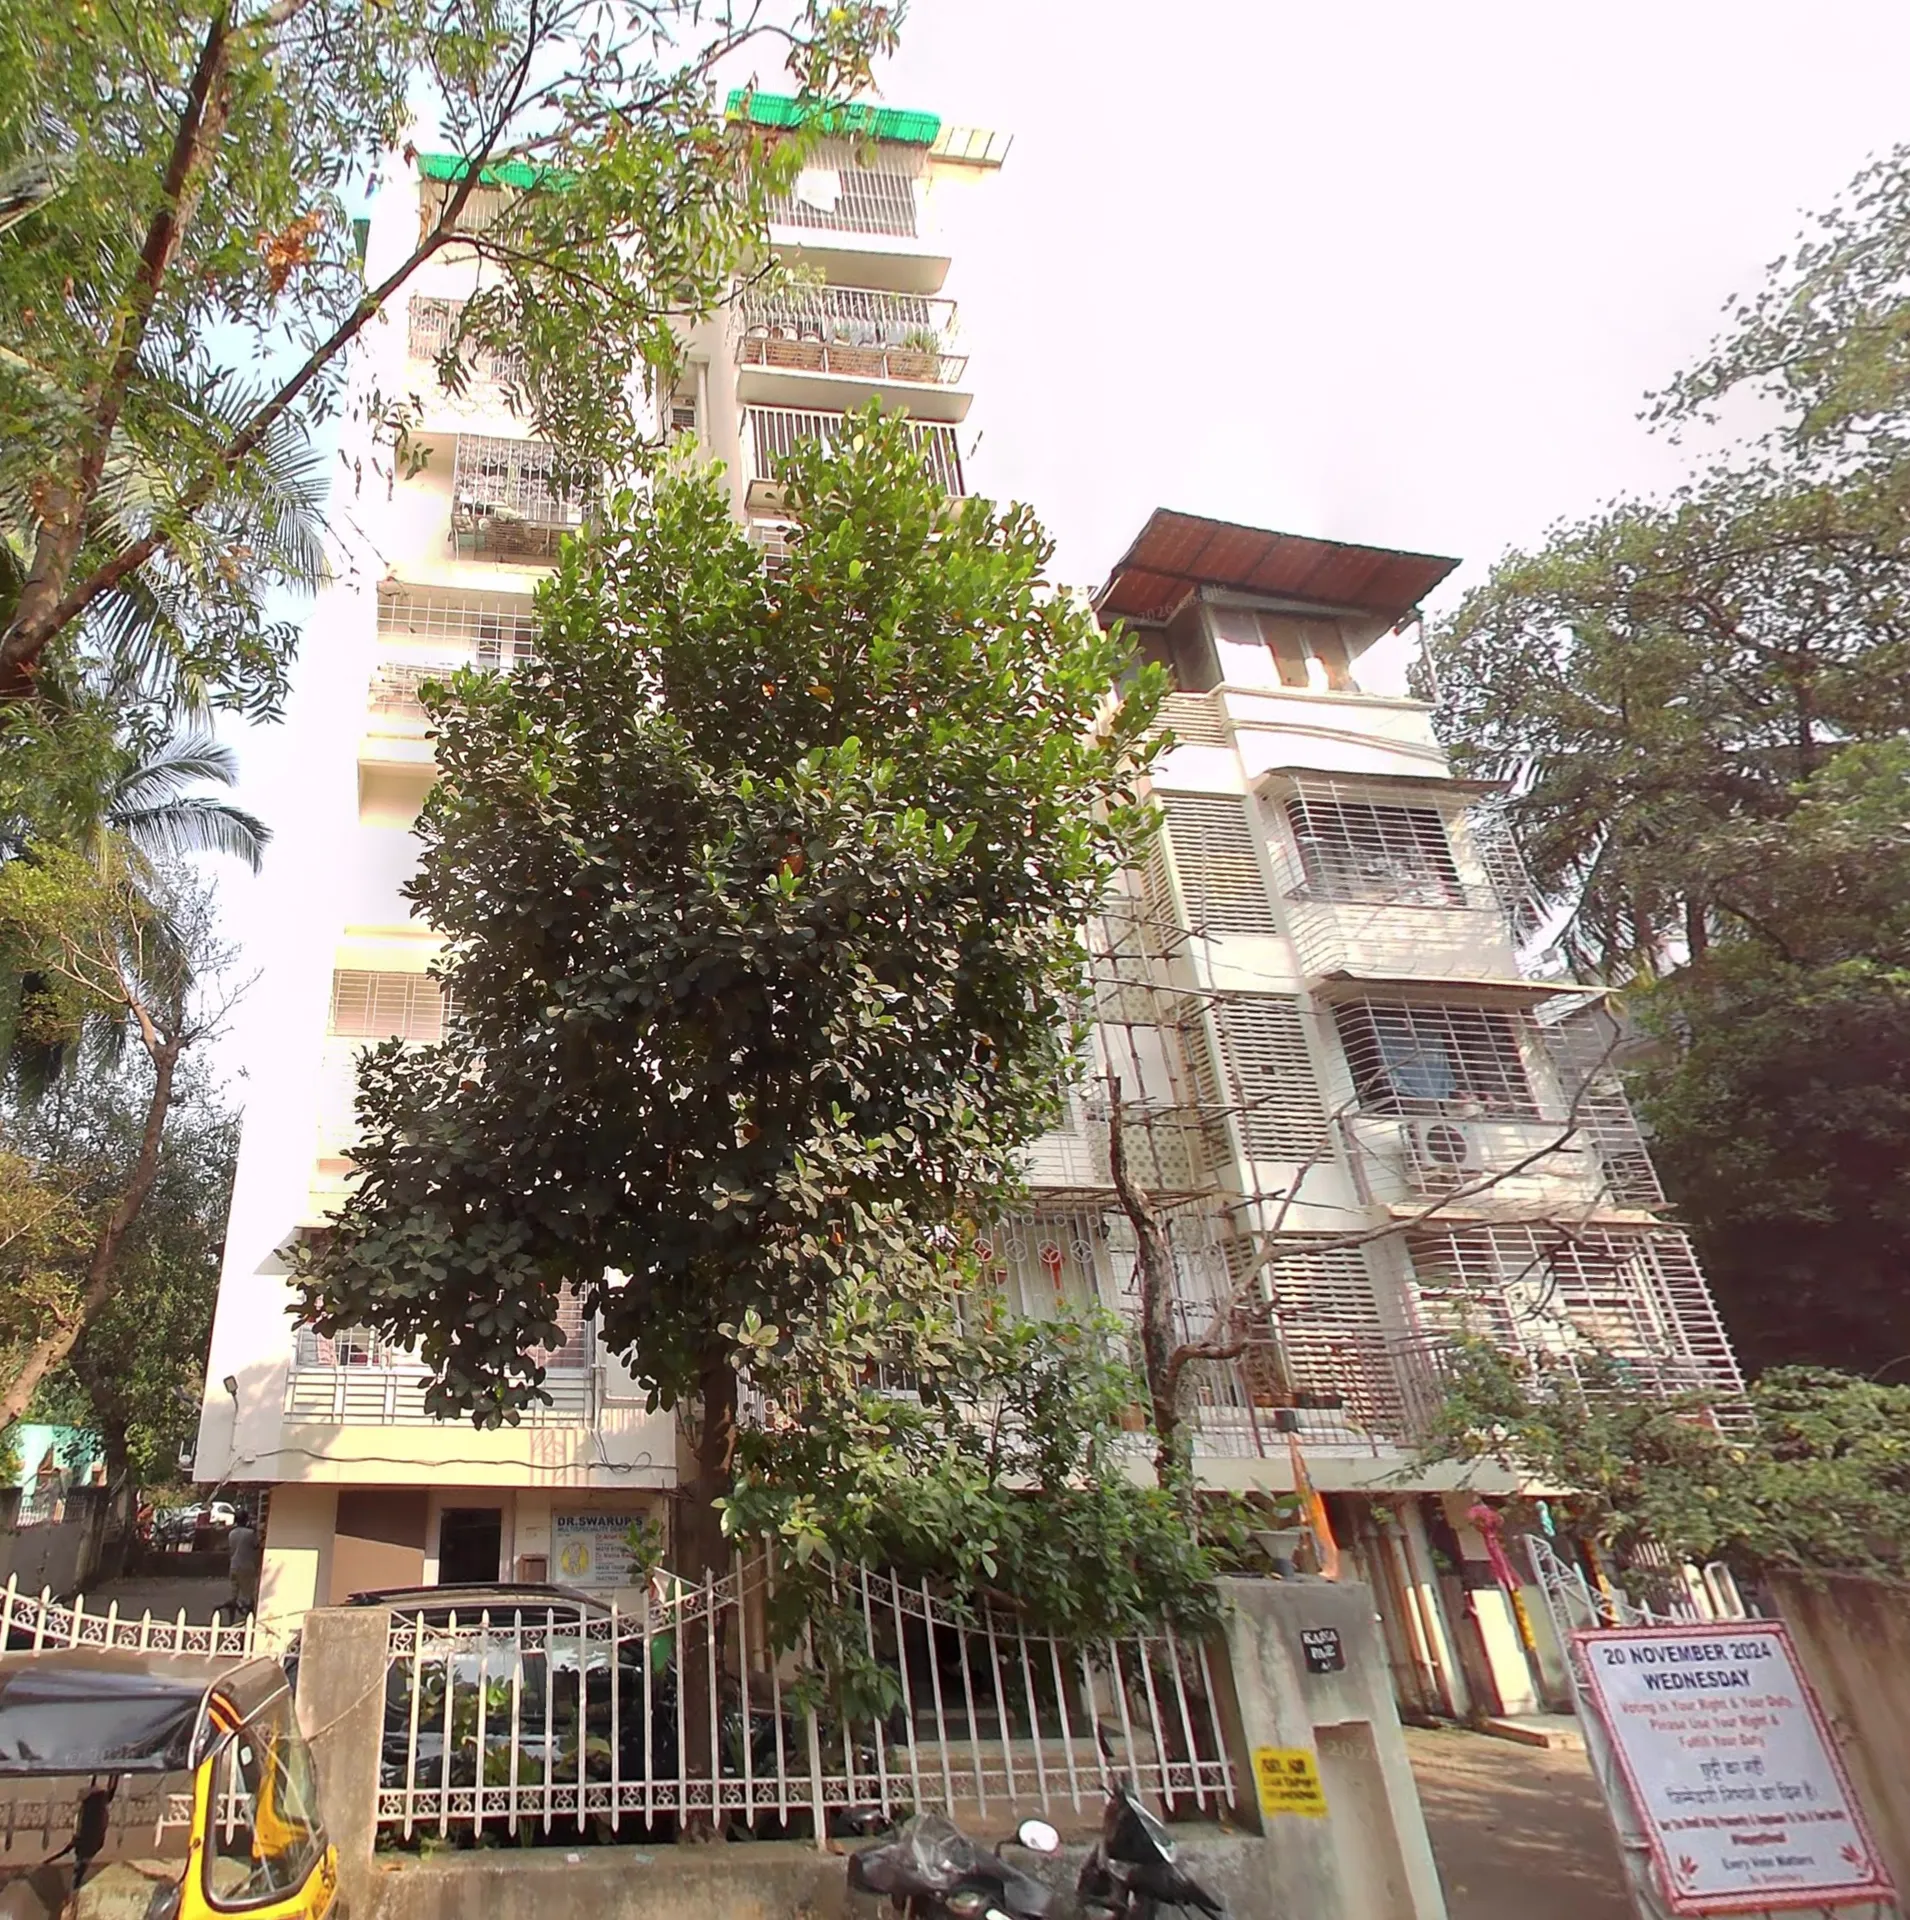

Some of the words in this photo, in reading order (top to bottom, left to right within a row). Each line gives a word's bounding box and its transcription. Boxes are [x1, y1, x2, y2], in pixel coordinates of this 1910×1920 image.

[1604, 1648, 1626, 1664] 20
[1630, 1644, 1727, 1664] NOVEMBER
[1728, 1642, 1772, 1659] 2024
[1643, 1669, 1752, 1690] WEDNESDAY
